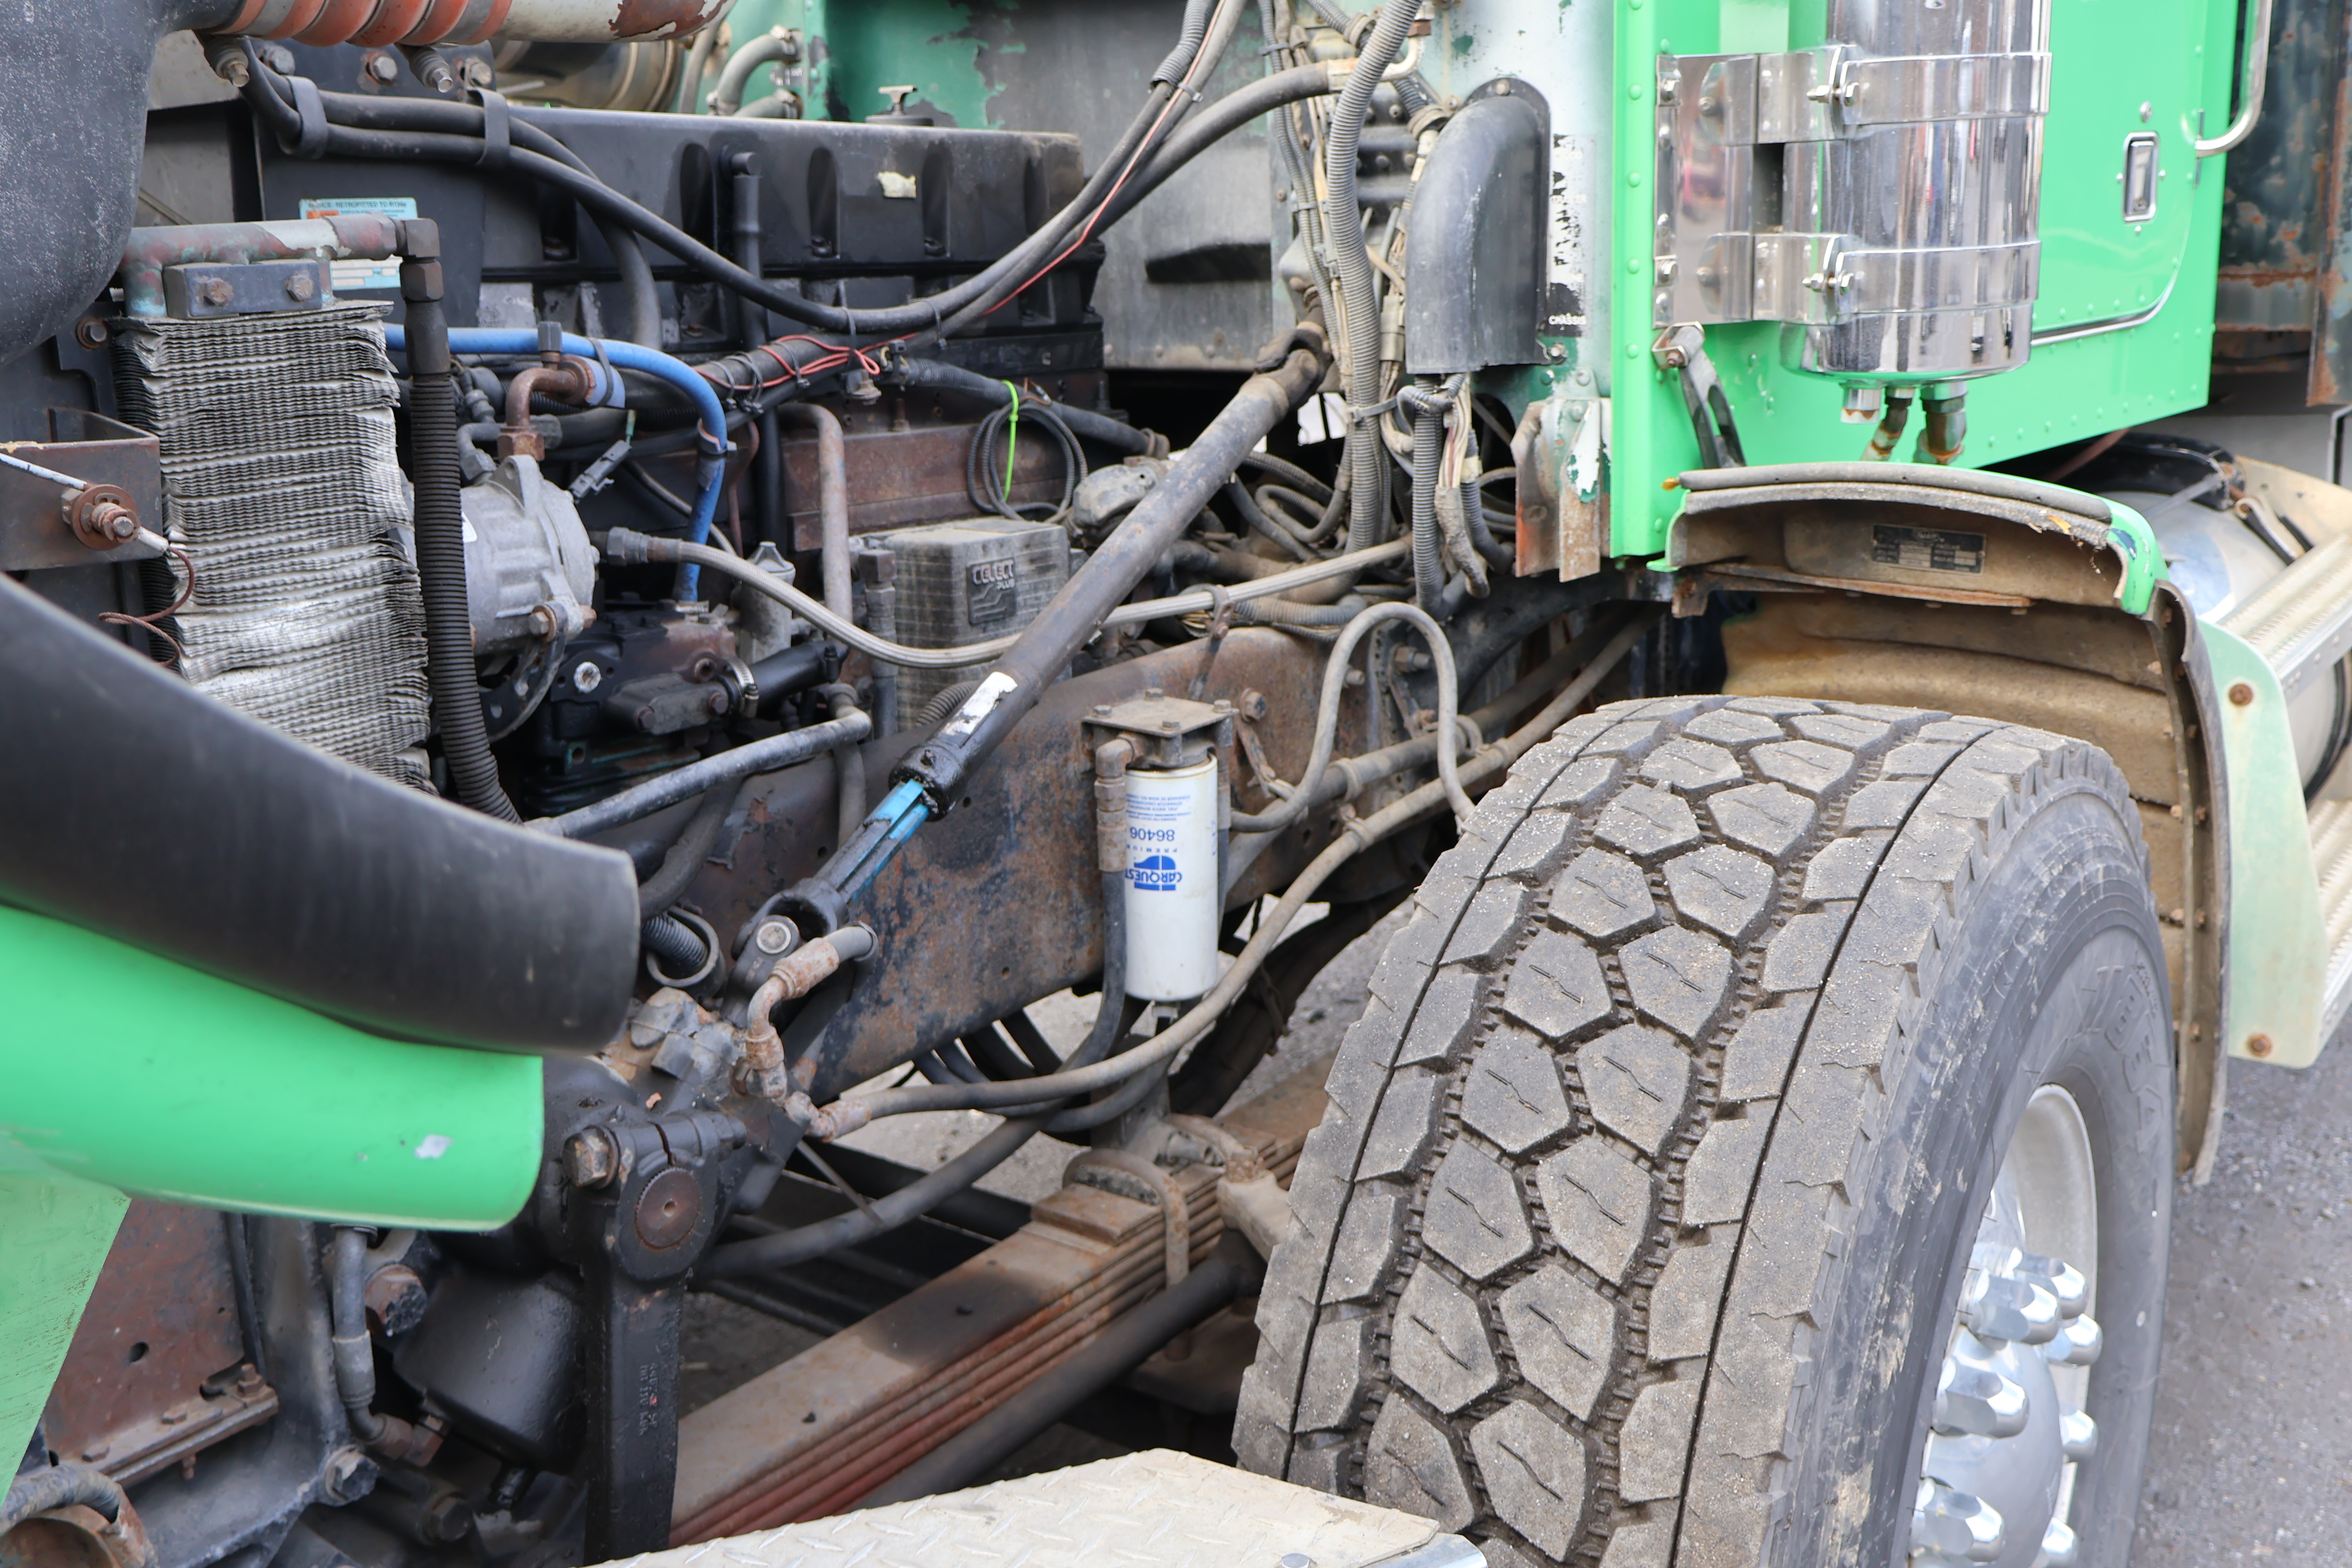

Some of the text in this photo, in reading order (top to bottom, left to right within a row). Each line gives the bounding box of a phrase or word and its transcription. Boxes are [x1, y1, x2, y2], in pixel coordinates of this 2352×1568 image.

[973, 559, 1014, 584] CELECT
[996, 579, 1016, 590] PLUS
[1130, 826, 1175, 841] 86406
[1127, 844, 1178, 852] PREMIUM
[1125, 870, 1182, 883] CARQUEST
